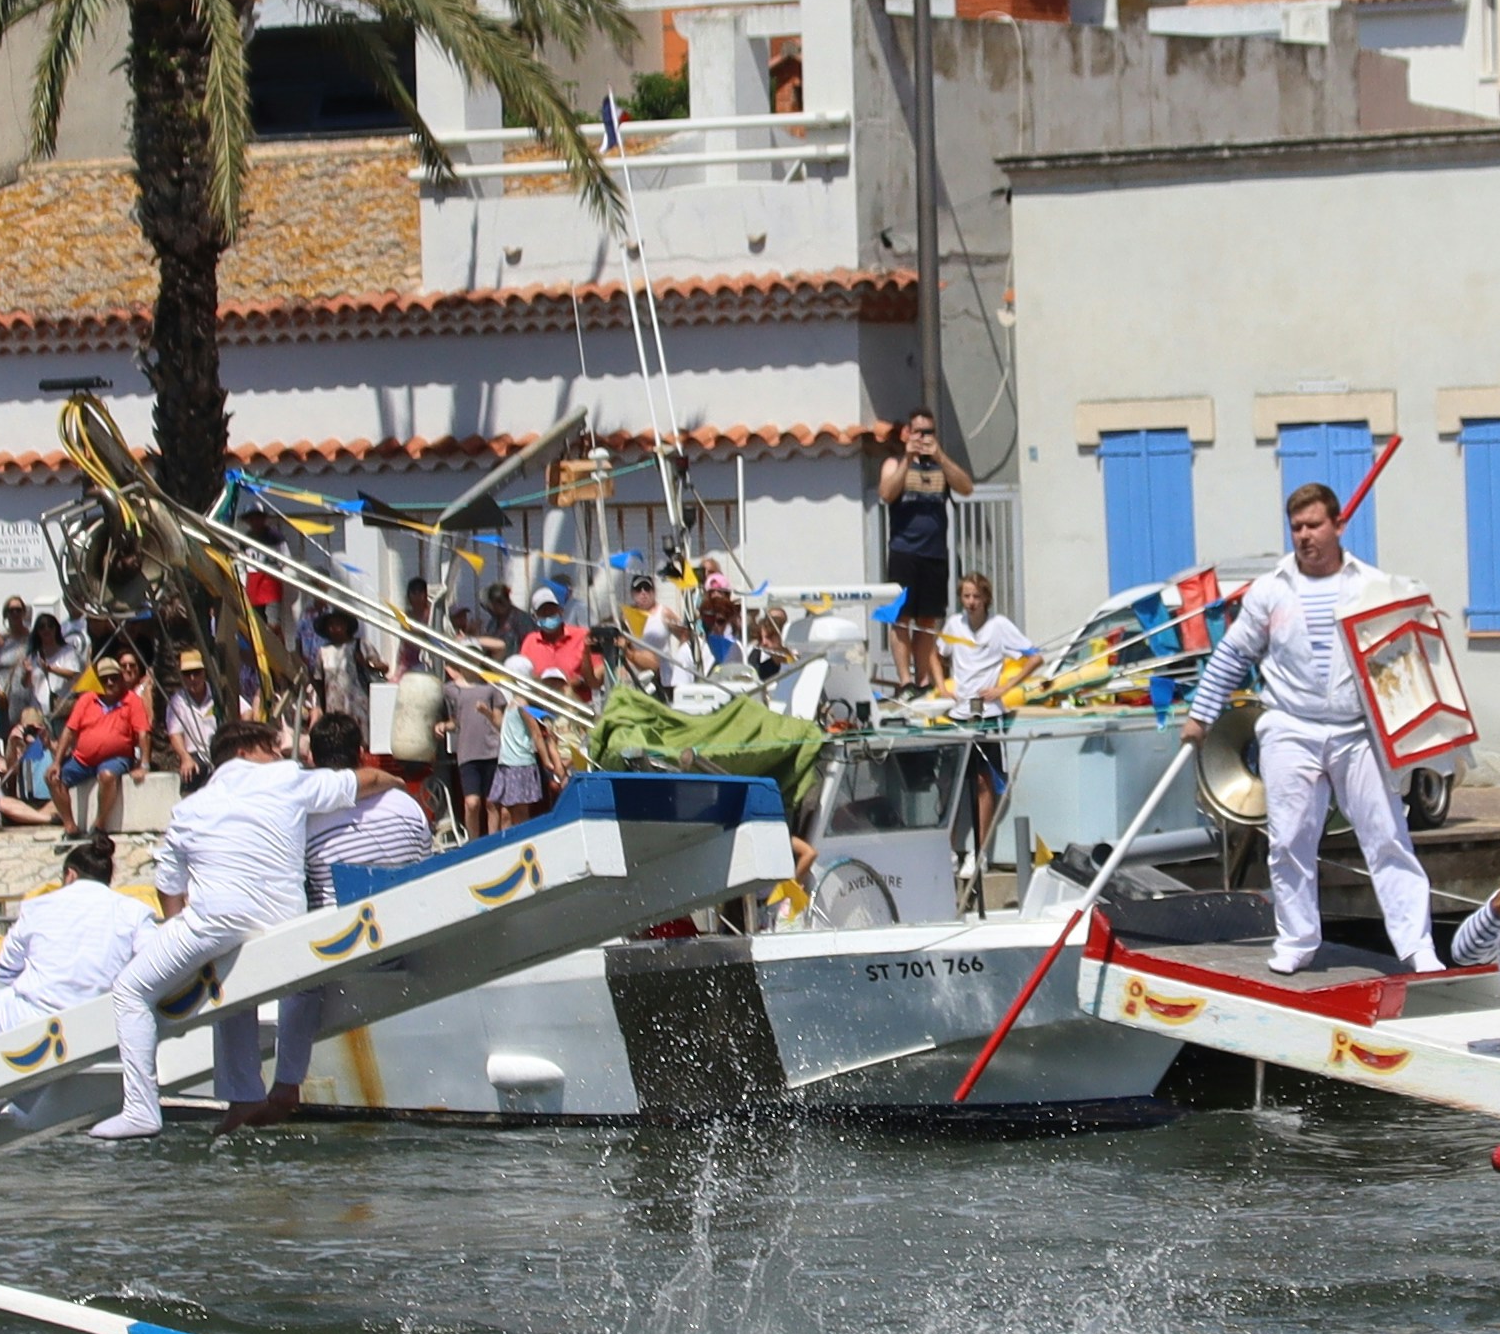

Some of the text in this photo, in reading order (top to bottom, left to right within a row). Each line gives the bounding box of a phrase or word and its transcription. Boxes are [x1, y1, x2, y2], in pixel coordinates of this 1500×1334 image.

[865, 955, 985, 983] ST 701 766
